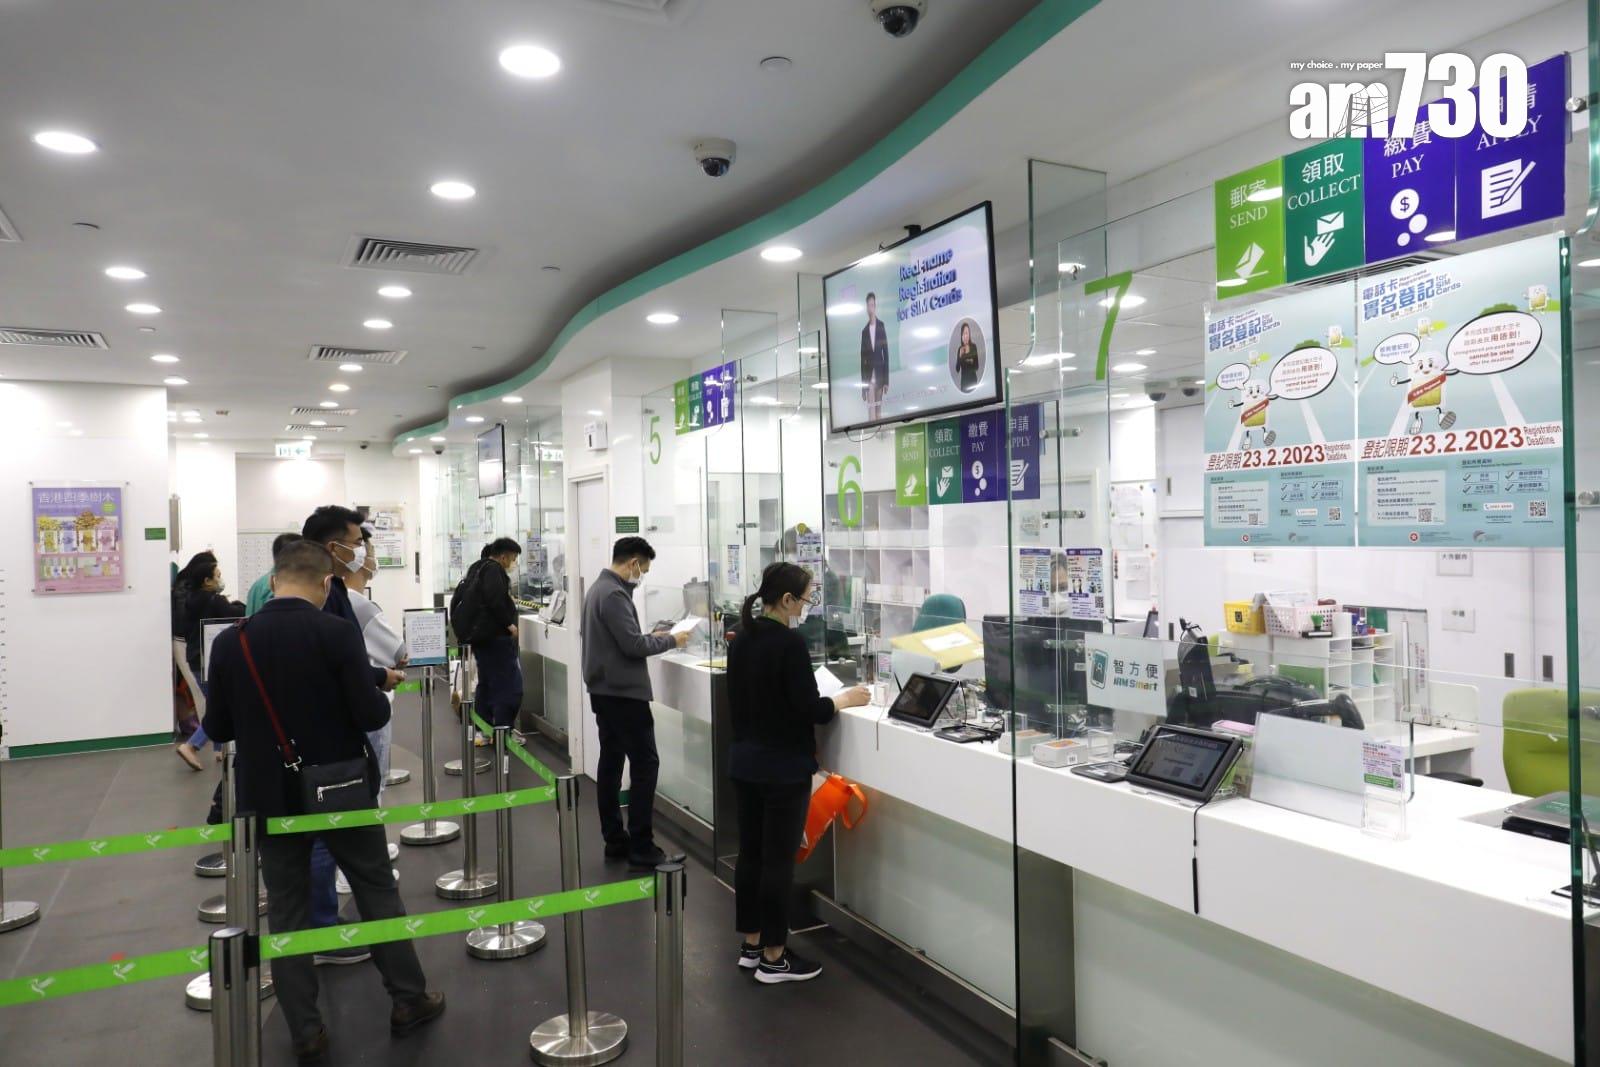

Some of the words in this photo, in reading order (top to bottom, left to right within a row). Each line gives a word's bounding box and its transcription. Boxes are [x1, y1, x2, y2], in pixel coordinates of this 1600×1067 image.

[1302, 153, 1344, 183] 領取
[1391, 154, 1424, 178] PAY
[1288, 174, 1360, 210] COLLECT
[1230, 206, 1267, 229] SEND
[899, 248, 953, 281] Real-name
[898, 269, 957, 302] Registration
[1363, 278, 1398, 300] 電話卡
[1436, 282, 1461, 296] Cards
[896, 307, 909, 321] for
[911, 299, 927, 317] SIM
[930, 288, 963, 310] Cards
[1085, 271, 1132, 380] 7
[650, 415, 661, 464] 5
[935, 428, 952, 443] 領取
[1524, 424, 1560, 437] Registration
[1526, 434, 1556, 446] Deadline
[929, 445, 960, 458] COLLECT
[971, 440, 985, 453] PAY
[1361, 437, 1410, 459] 登記限期
[1410, 427, 1524, 455] 23.2.2023
[1242, 445, 1325, 468] 23.2.2023
[838, 455, 862, 528] 6
[1113, 660, 1159, 679] 智方便
[1129, 680, 1158, 691] Smart
